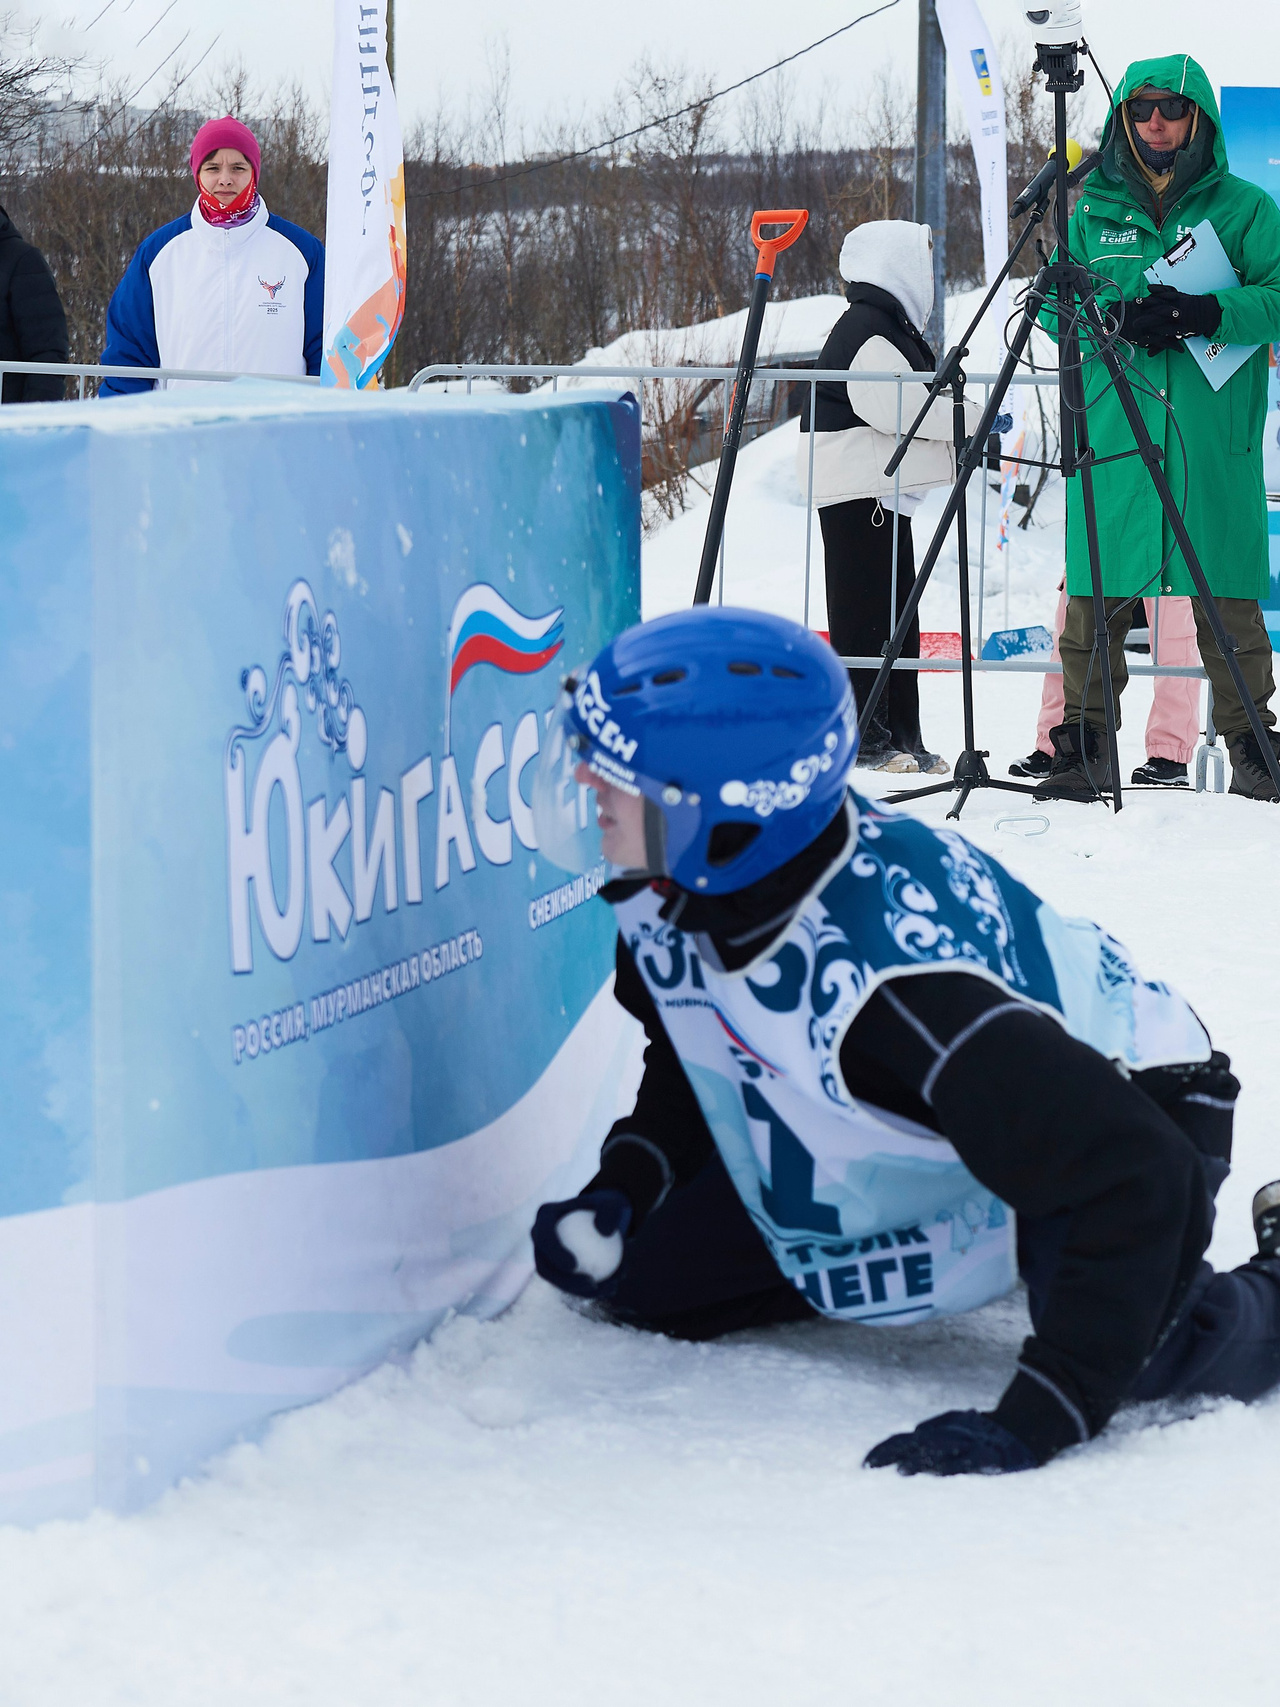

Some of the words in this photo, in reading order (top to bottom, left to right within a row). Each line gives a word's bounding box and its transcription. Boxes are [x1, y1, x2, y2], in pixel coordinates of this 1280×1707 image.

[233, 1002, 311, 1066] РОССИЯ,
[310, 954, 421, 1034] МУРМАНСКАЯ
[420, 927, 484, 984] ОБЛАСТЬ
